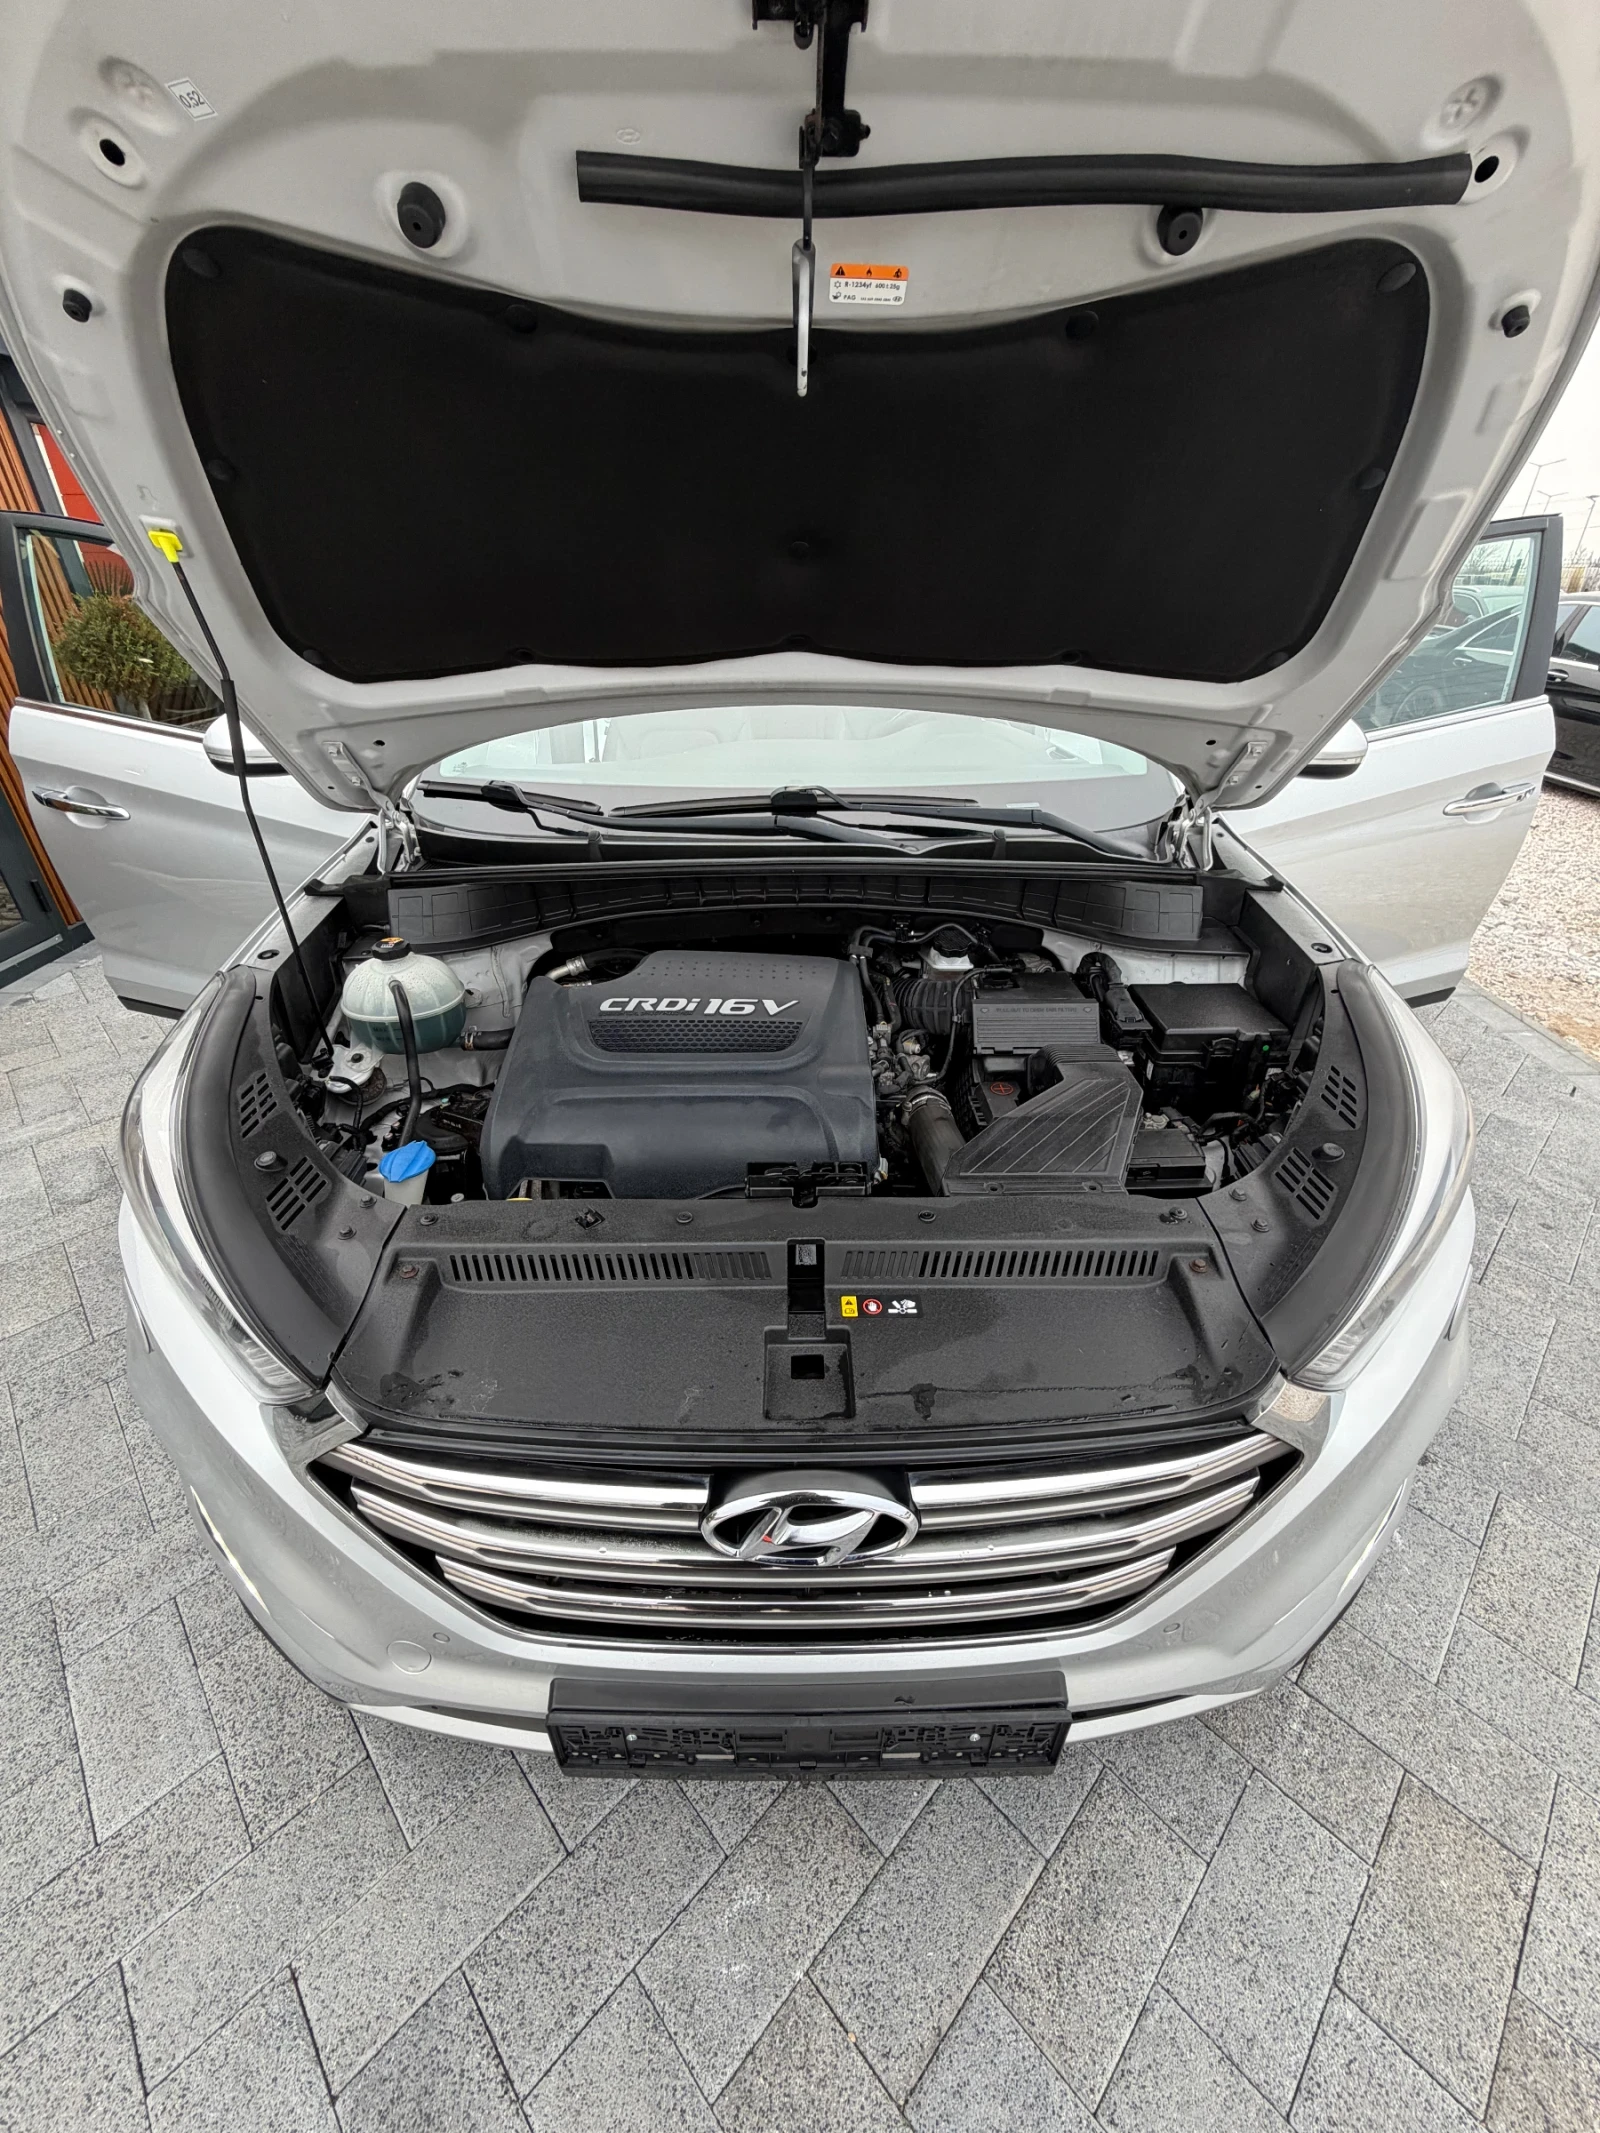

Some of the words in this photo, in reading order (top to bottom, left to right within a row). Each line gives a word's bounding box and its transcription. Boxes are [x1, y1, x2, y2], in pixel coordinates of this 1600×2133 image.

[179, 91, 205, 109] 0.52
[844, 281, 873, 290] R-1234yf
[600, 998, 701, 1012] CRDi
